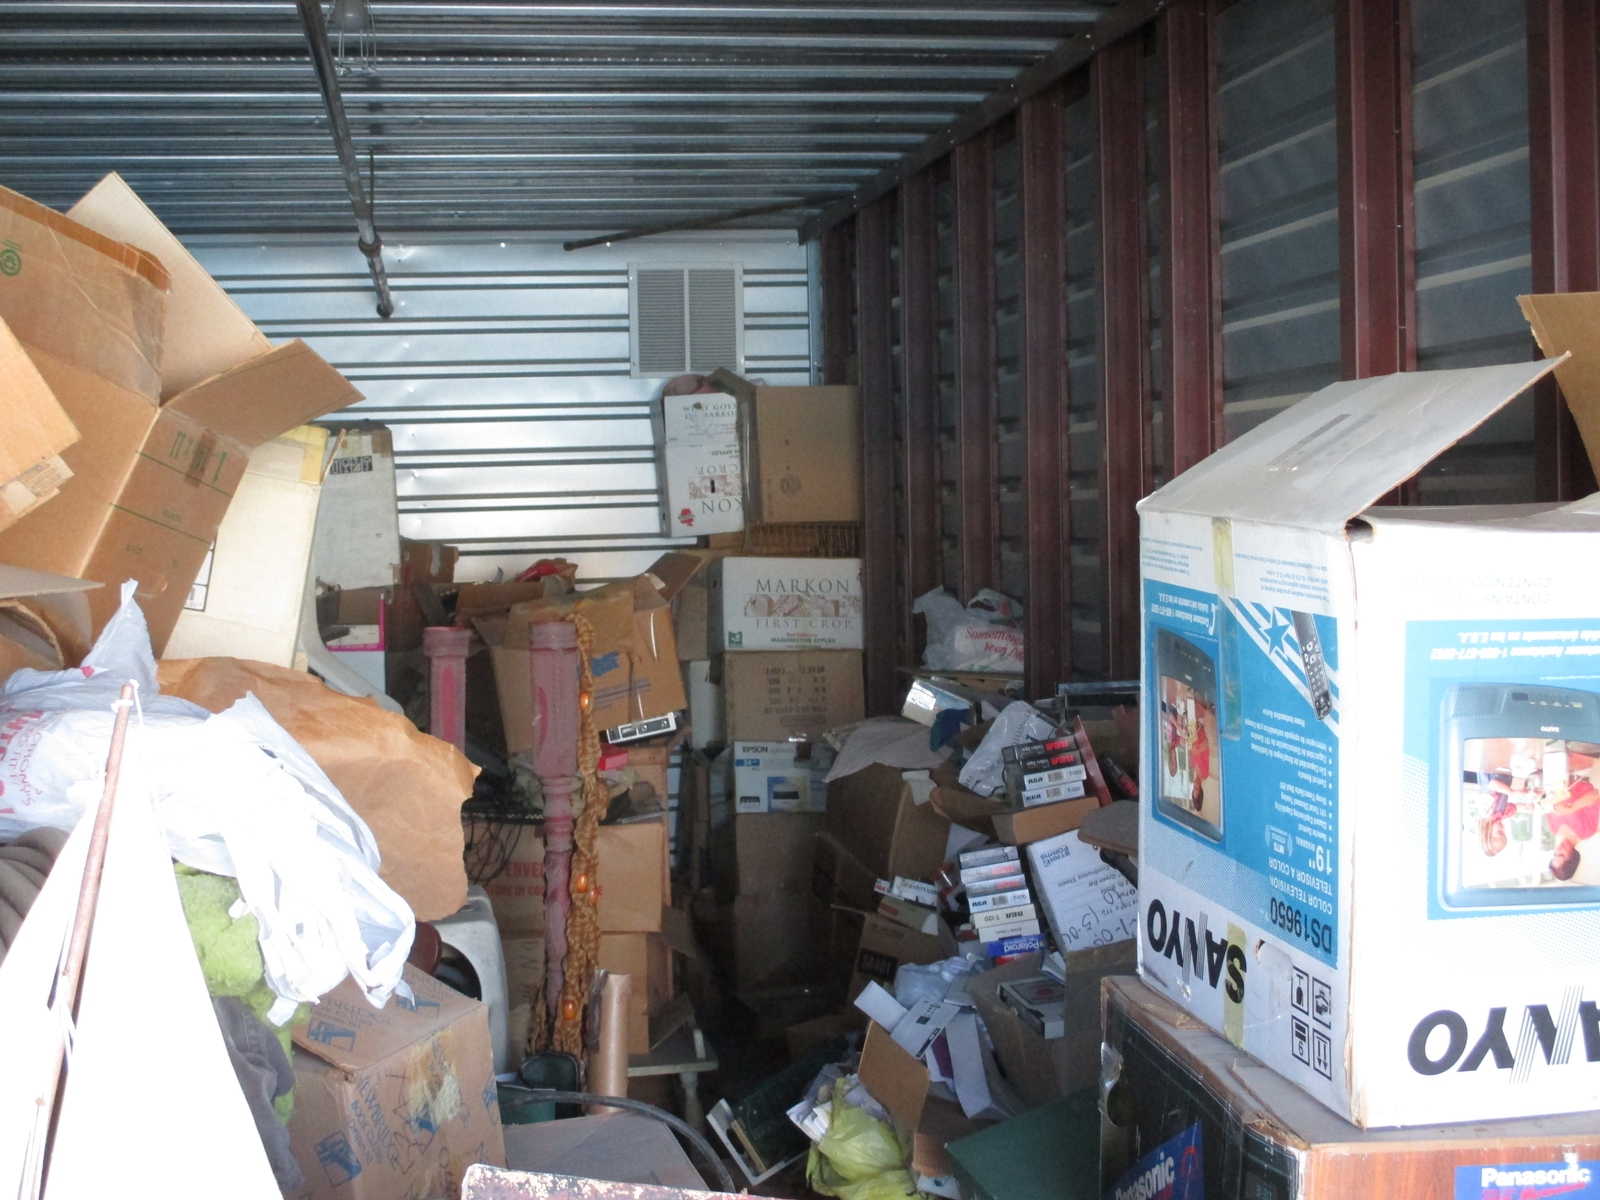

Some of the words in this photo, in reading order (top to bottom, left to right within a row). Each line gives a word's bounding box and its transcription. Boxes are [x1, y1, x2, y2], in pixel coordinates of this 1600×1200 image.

[756, 578, 849, 593] MARKON
[756, 618, 799, 628] FIRST
[1510, 646, 1564, 658] Assistance
[1540, 725, 1560, 733] SANYO
[1045, 740, 1069, 751] RCA
[1051, 754, 1075, 765] RCA
[1028, 776, 1043, 784] RCA
[1068, 769, 1082, 777] T-120
[1312, 775, 1327, 787] Control
[1026, 793, 1041, 801] RCA
[1293, 808, 1313, 825] Captioning
[1298, 823, 1312, 836] Control
[1312, 828, 1327, 842] Remote
[1273, 842, 1284, 855] MTS
[1268, 856, 1290, 875] COLOR
[1308, 845, 1332, 875] 19"
[1077, 865, 1110, 881] Continuous
[1099, 873, 1116, 884] Green
[1057, 877, 1077, 888] Sheets
[1269, 875, 1307, 902] TELEVISION
[1296, 869, 1332, 895] TELEVISOR
[972, 899, 987, 907] RCA
[1308, 894, 1332, 915] COLOR
[984, 914, 1000, 922] T-120
[1005, 911, 1023, 919] RCA
[1270, 897, 1332, 955] DS19650
[1003, 941, 1040, 953] Polaroid
[1147, 898, 1247, 1004] SANYO
[327, 996, 395, 1025] BRIDGE
[1407, 985, 1600, 1085] ANYO
[351, 1099, 368, 1133] BOOK
[1481, 1166, 1591, 1188] Panasonic
